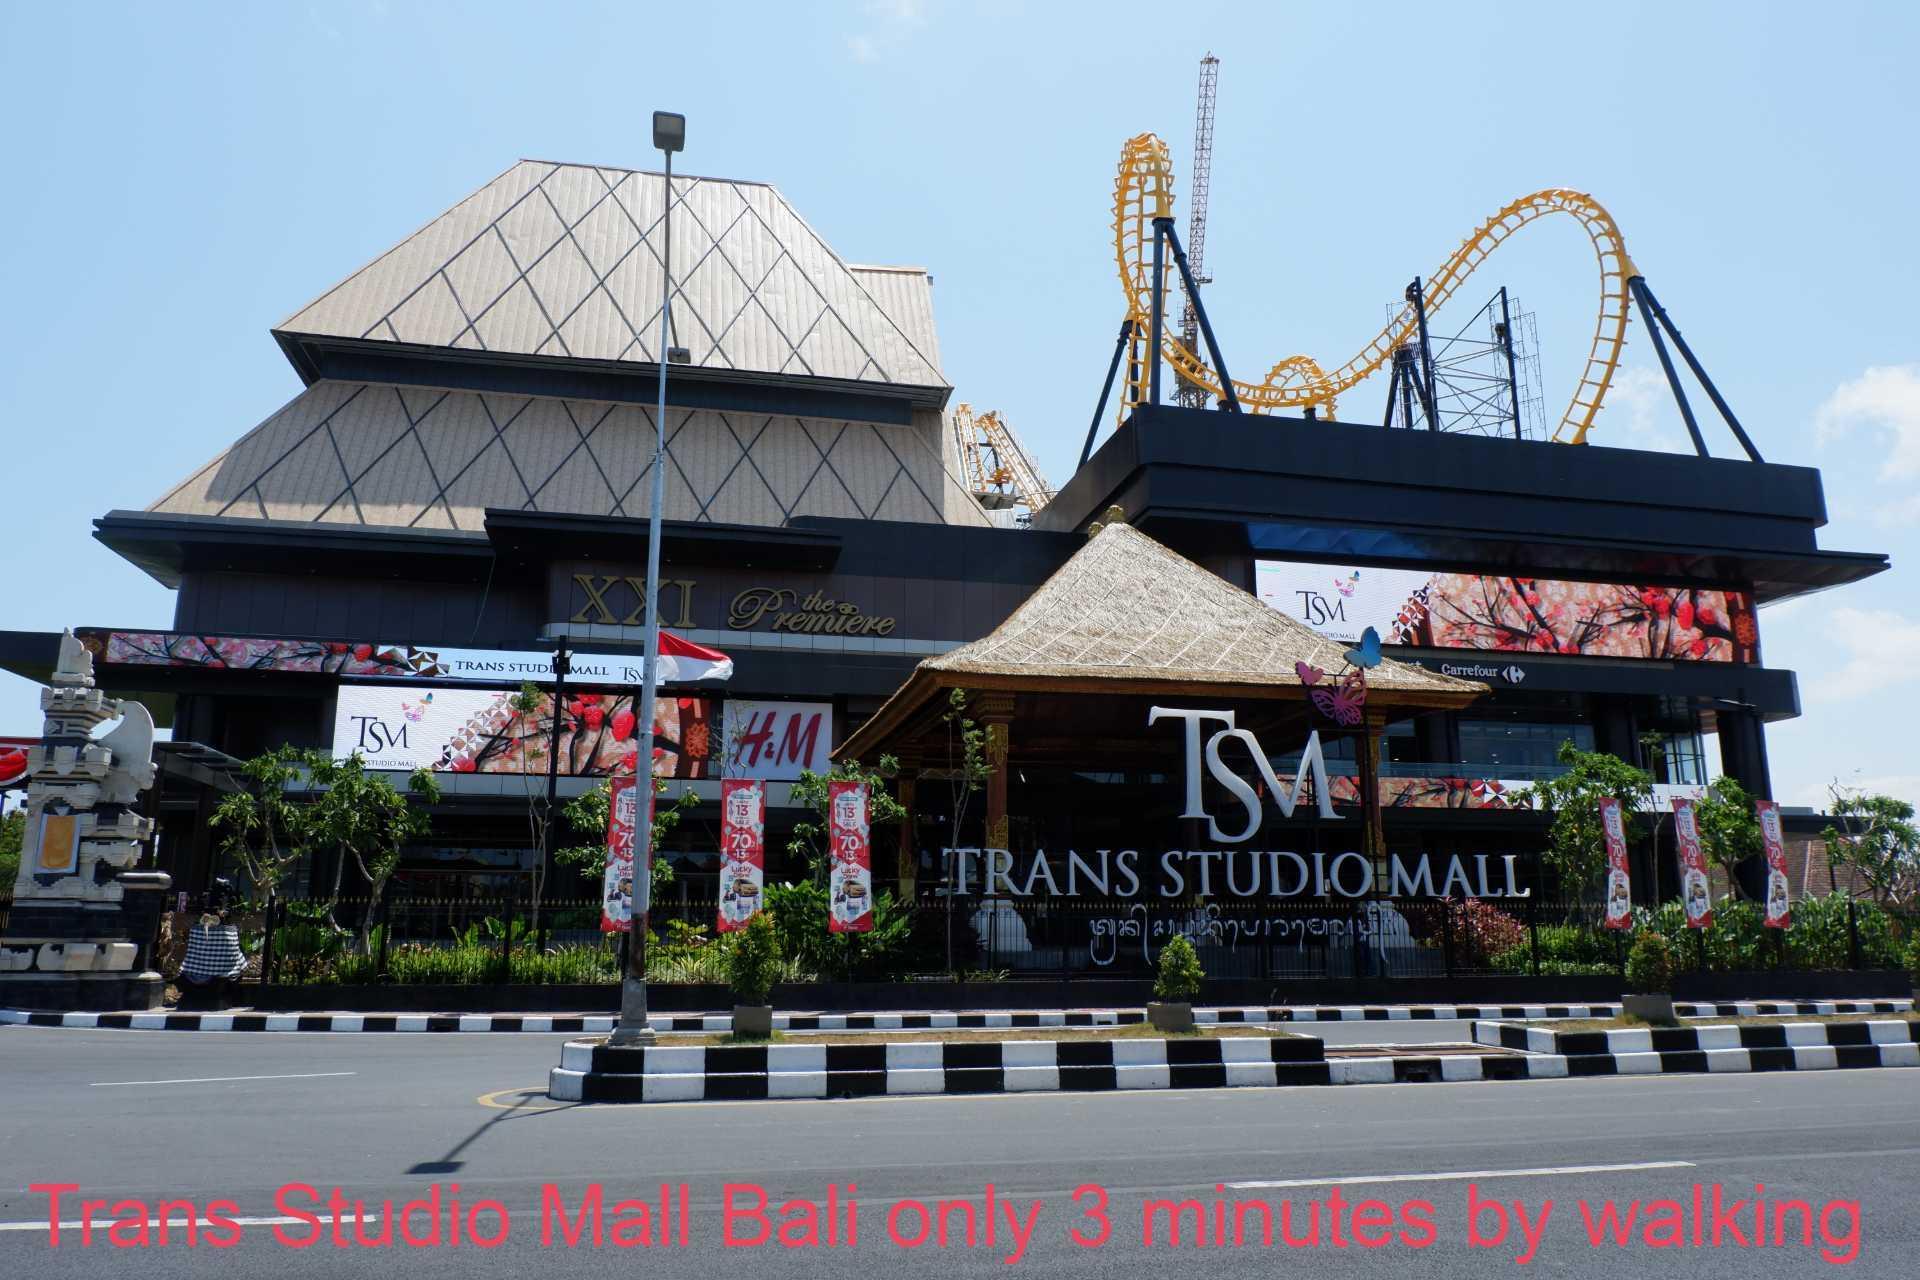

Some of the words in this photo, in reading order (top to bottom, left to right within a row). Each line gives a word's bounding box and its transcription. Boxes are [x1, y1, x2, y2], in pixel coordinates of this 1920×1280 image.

[570, 574, 697, 628] XXI
[728, 587, 896, 636] Premiere
[802, 589, 834, 613] the
[1296, 590, 1347, 626] TSM
[456, 660, 504, 672] TRANS
[509, 662, 553, 674] STUDI
[569, 665, 609, 676] MALL
[1441, 663, 1498, 677] Carrefour
[351, 715, 410, 753] TSM
[732, 711, 822, 768] H&M
[1148, 706, 1346, 843] TSM
[735, 804, 749, 816] 13
[843, 807, 855, 819] 13
[941, 848, 1140, 897] TRANS
[1160, 850, 1374, 899] STUDIO
[1387, 853, 1531, 898] MALL
